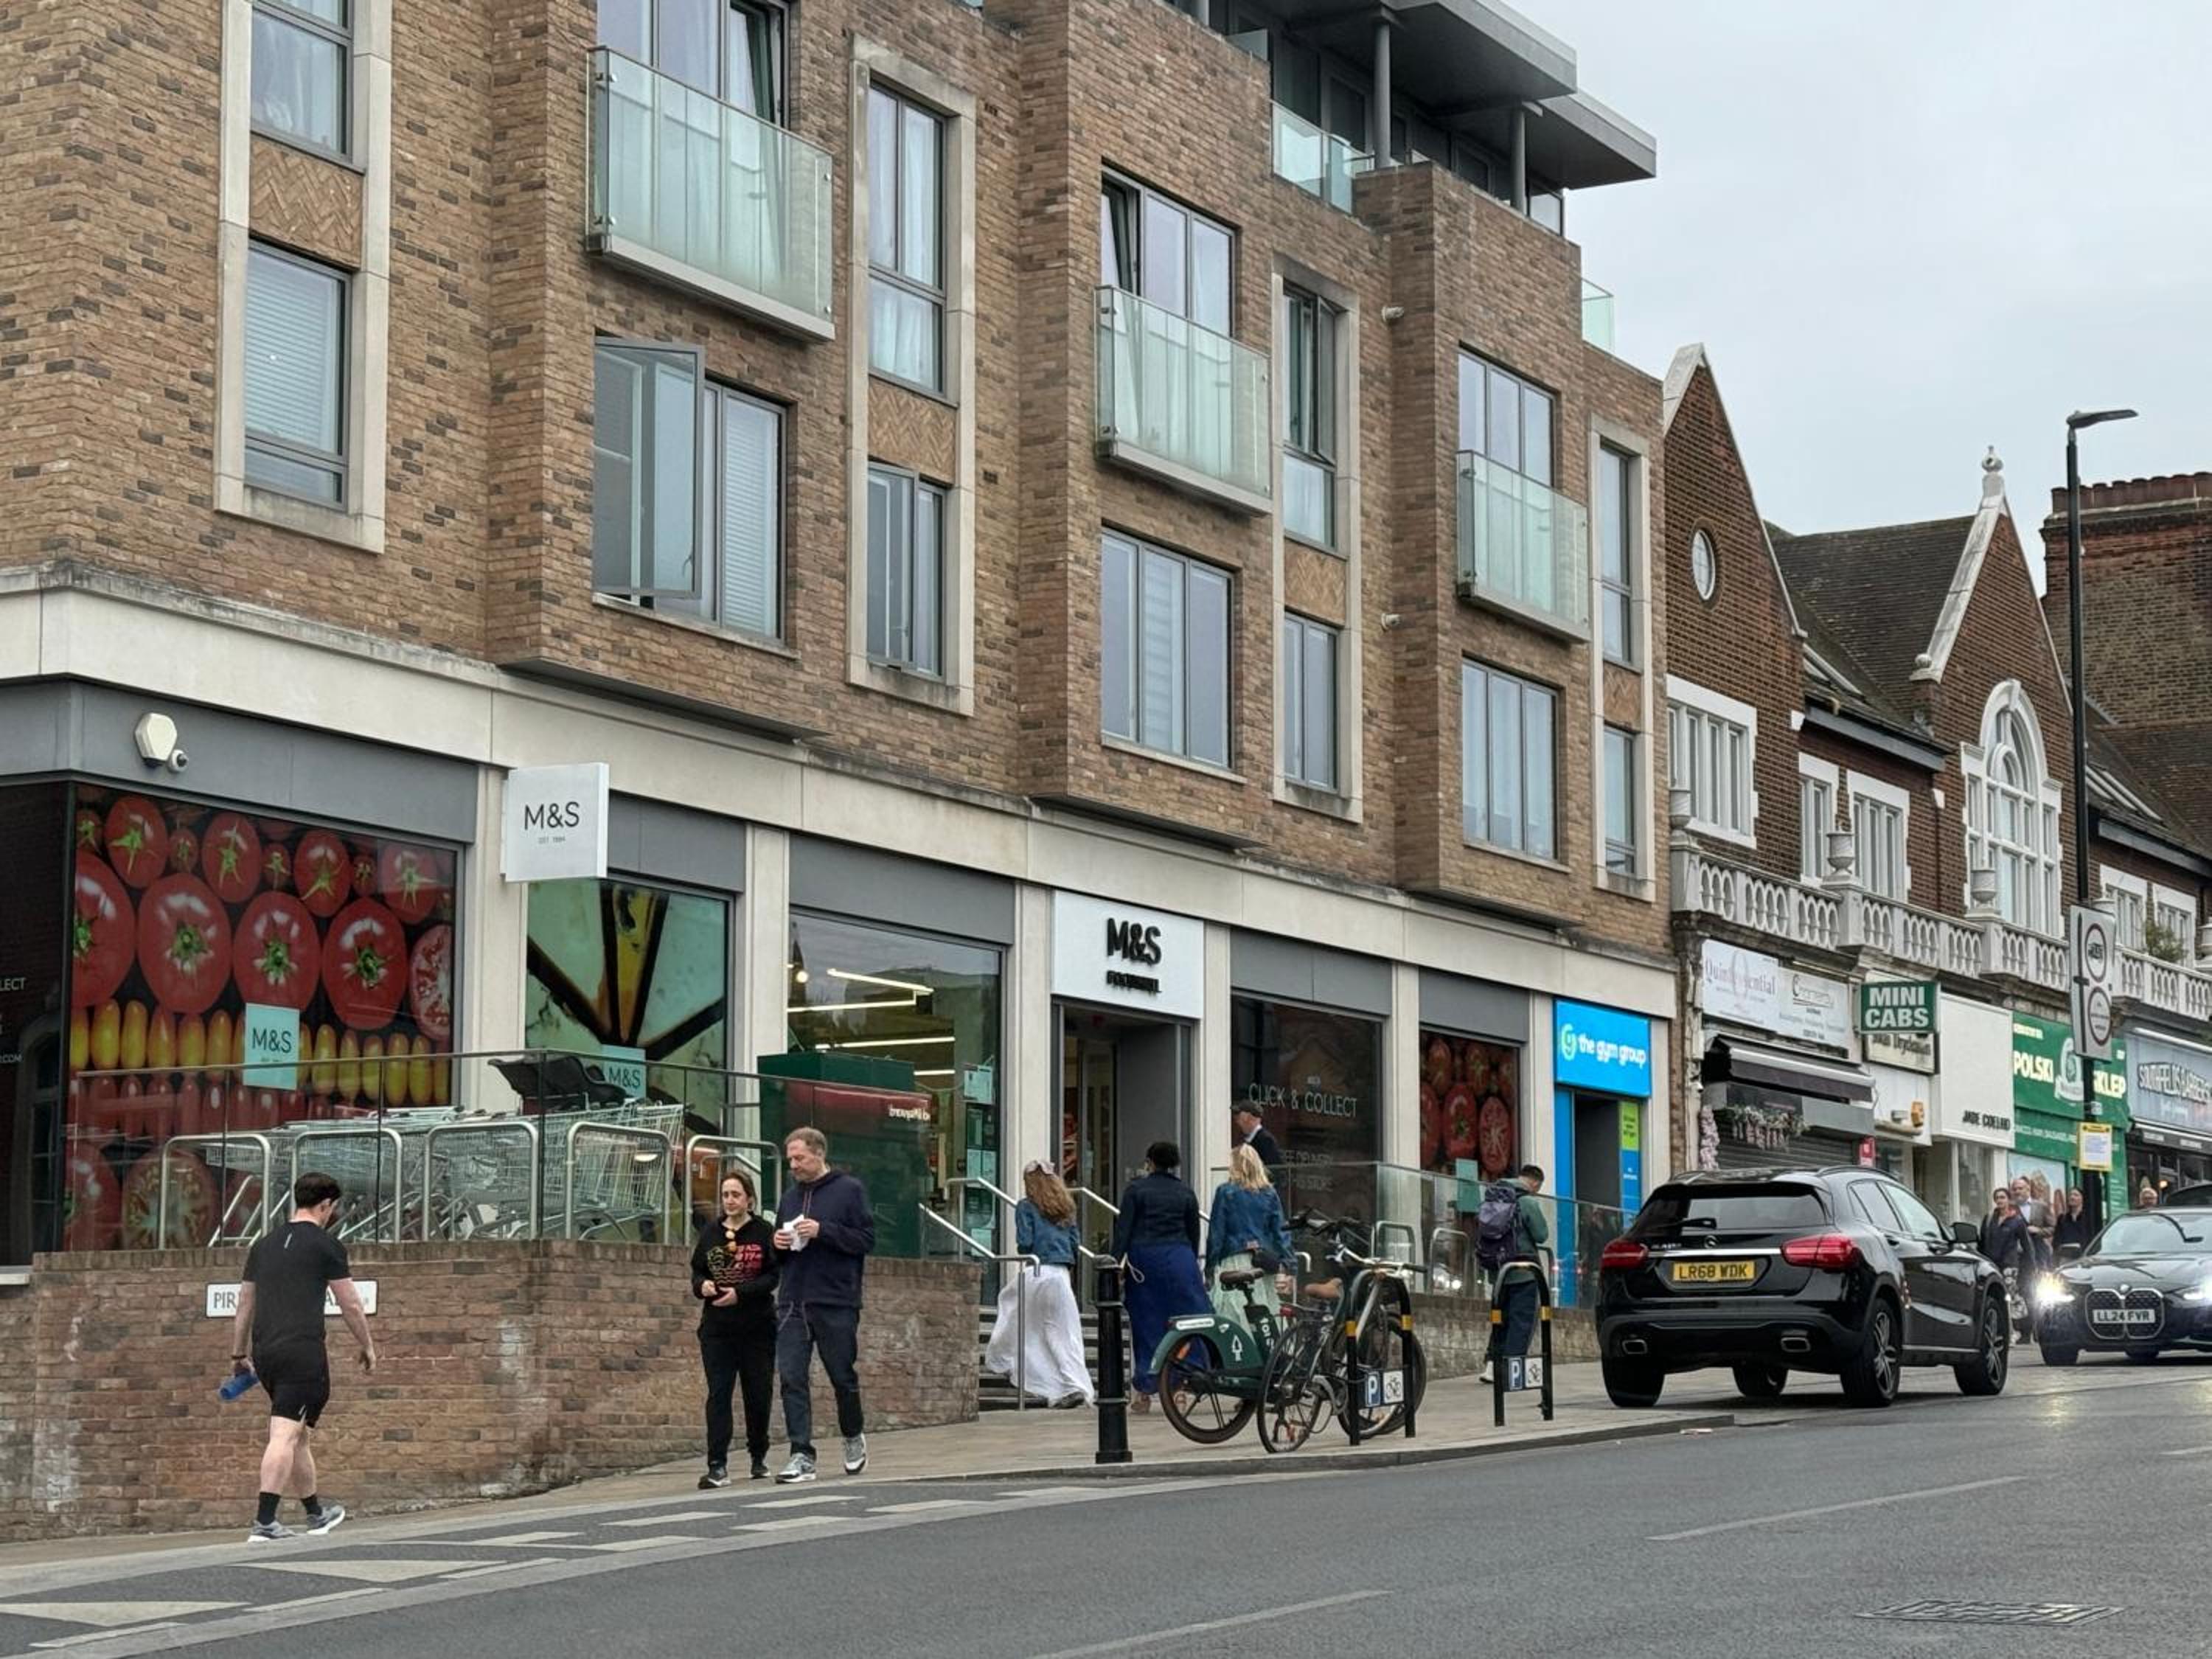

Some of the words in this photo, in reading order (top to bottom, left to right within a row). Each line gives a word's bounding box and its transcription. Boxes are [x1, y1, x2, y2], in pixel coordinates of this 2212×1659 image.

[524, 801, 580, 830] M&S
[1107, 918, 1162, 967] M&S
[1869, 986, 1925, 1006] MINI
[1865, 1008, 1930, 1029] CABS
[251, 1027, 292, 1054] M&S
[1578, 1032, 1595, 1054] the
[1596, 1040, 1618, 1062] gym
[1619, 1045, 1646, 1069] group
[608, 1066, 641, 1090] M&S
[2014, 1050, 2054, 1084] POLSKI
[1248, 1082, 1287, 1108] CLICK
[1291, 1088, 1299, 1110] &
[1304, 1091, 1358, 1118] COLLECT
[1678, 1265, 1716, 1279] LR68
[1720, 1264, 1747, 1278] WDK
[1512, 1360, 1520, 1387] P
[1367, 1376, 1379, 1405] P
